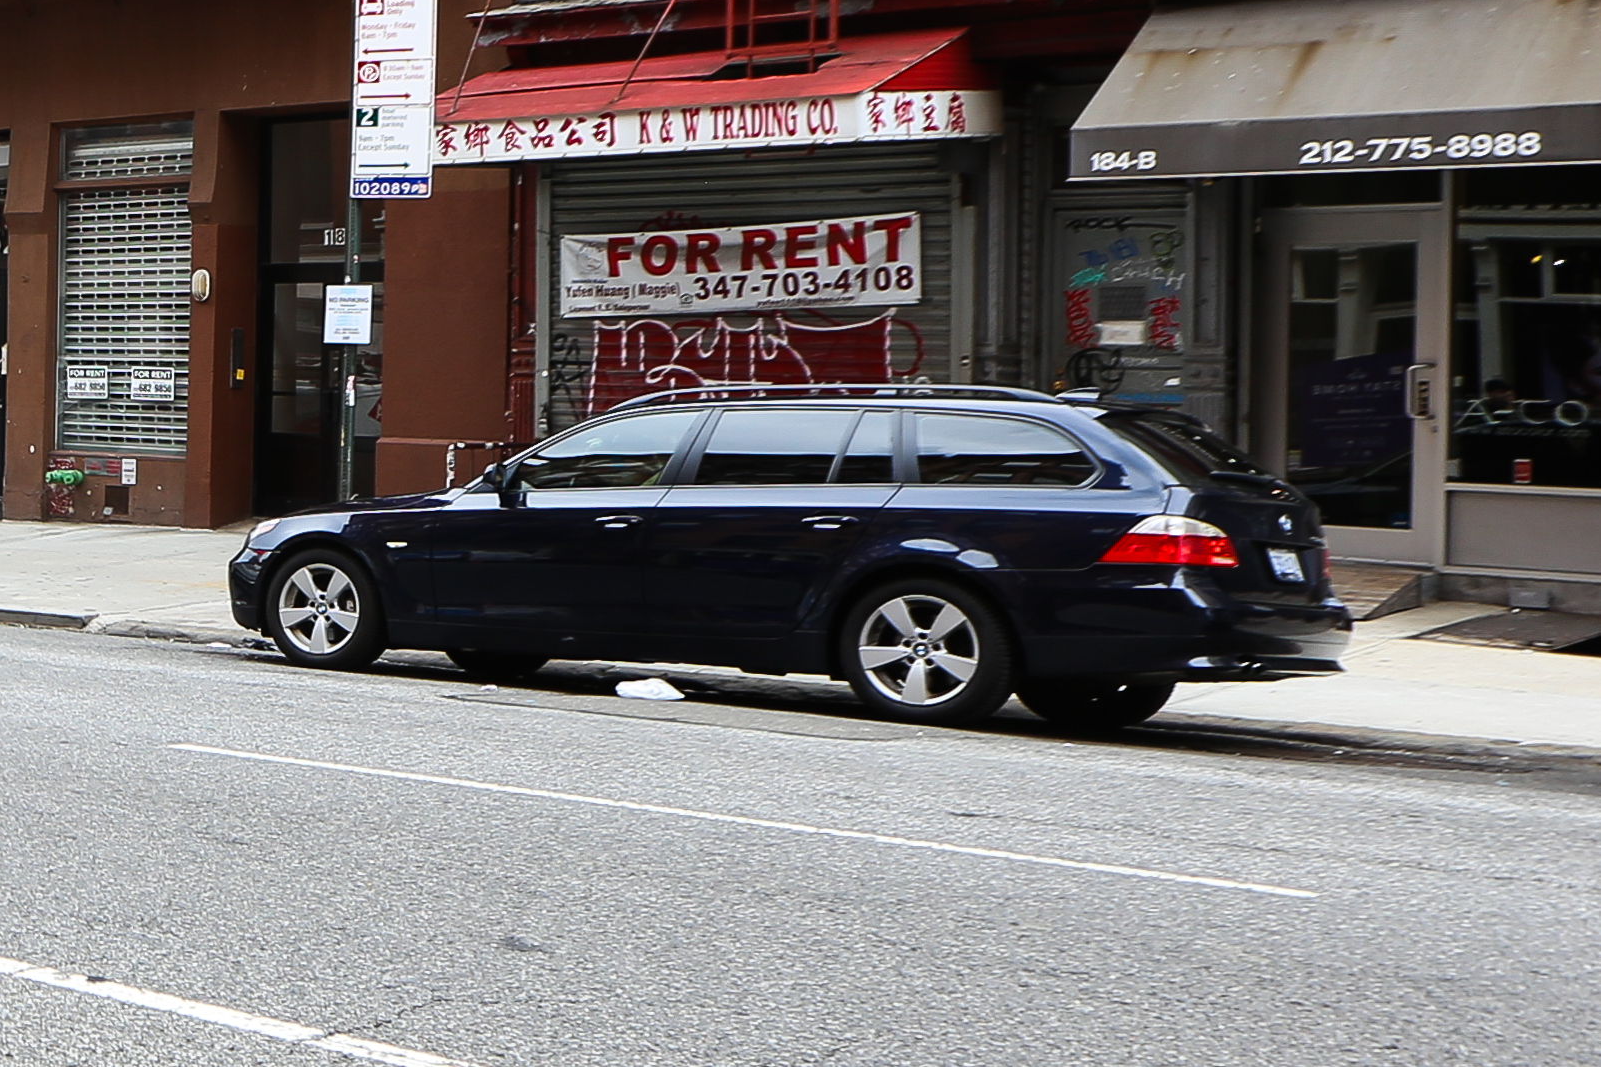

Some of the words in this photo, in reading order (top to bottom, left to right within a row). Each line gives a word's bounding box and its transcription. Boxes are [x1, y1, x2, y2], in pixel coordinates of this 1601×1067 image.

[360, 107, 375, 126] 2
[638, 110, 653, 145] K
[660, 109, 674, 143] &
[680, 107, 702, 142] W
[710, 97, 799, 140] TRADING
[807, 97, 839, 136] CO.
[1088, 151, 1157, 172] 184-B
[1299, 132, 1542, 165] 212-775-8988
[354, 182, 410, 195] 102089
[606, 232, 722, 278] FOR
[740, 217, 914, 272] RENT
[693, 264, 914, 301] 347-703-4108
[70, 369, 84, 377] FOR
[134, 370, 150, 378] FOR
[151, 370, 170, 379] RENT
